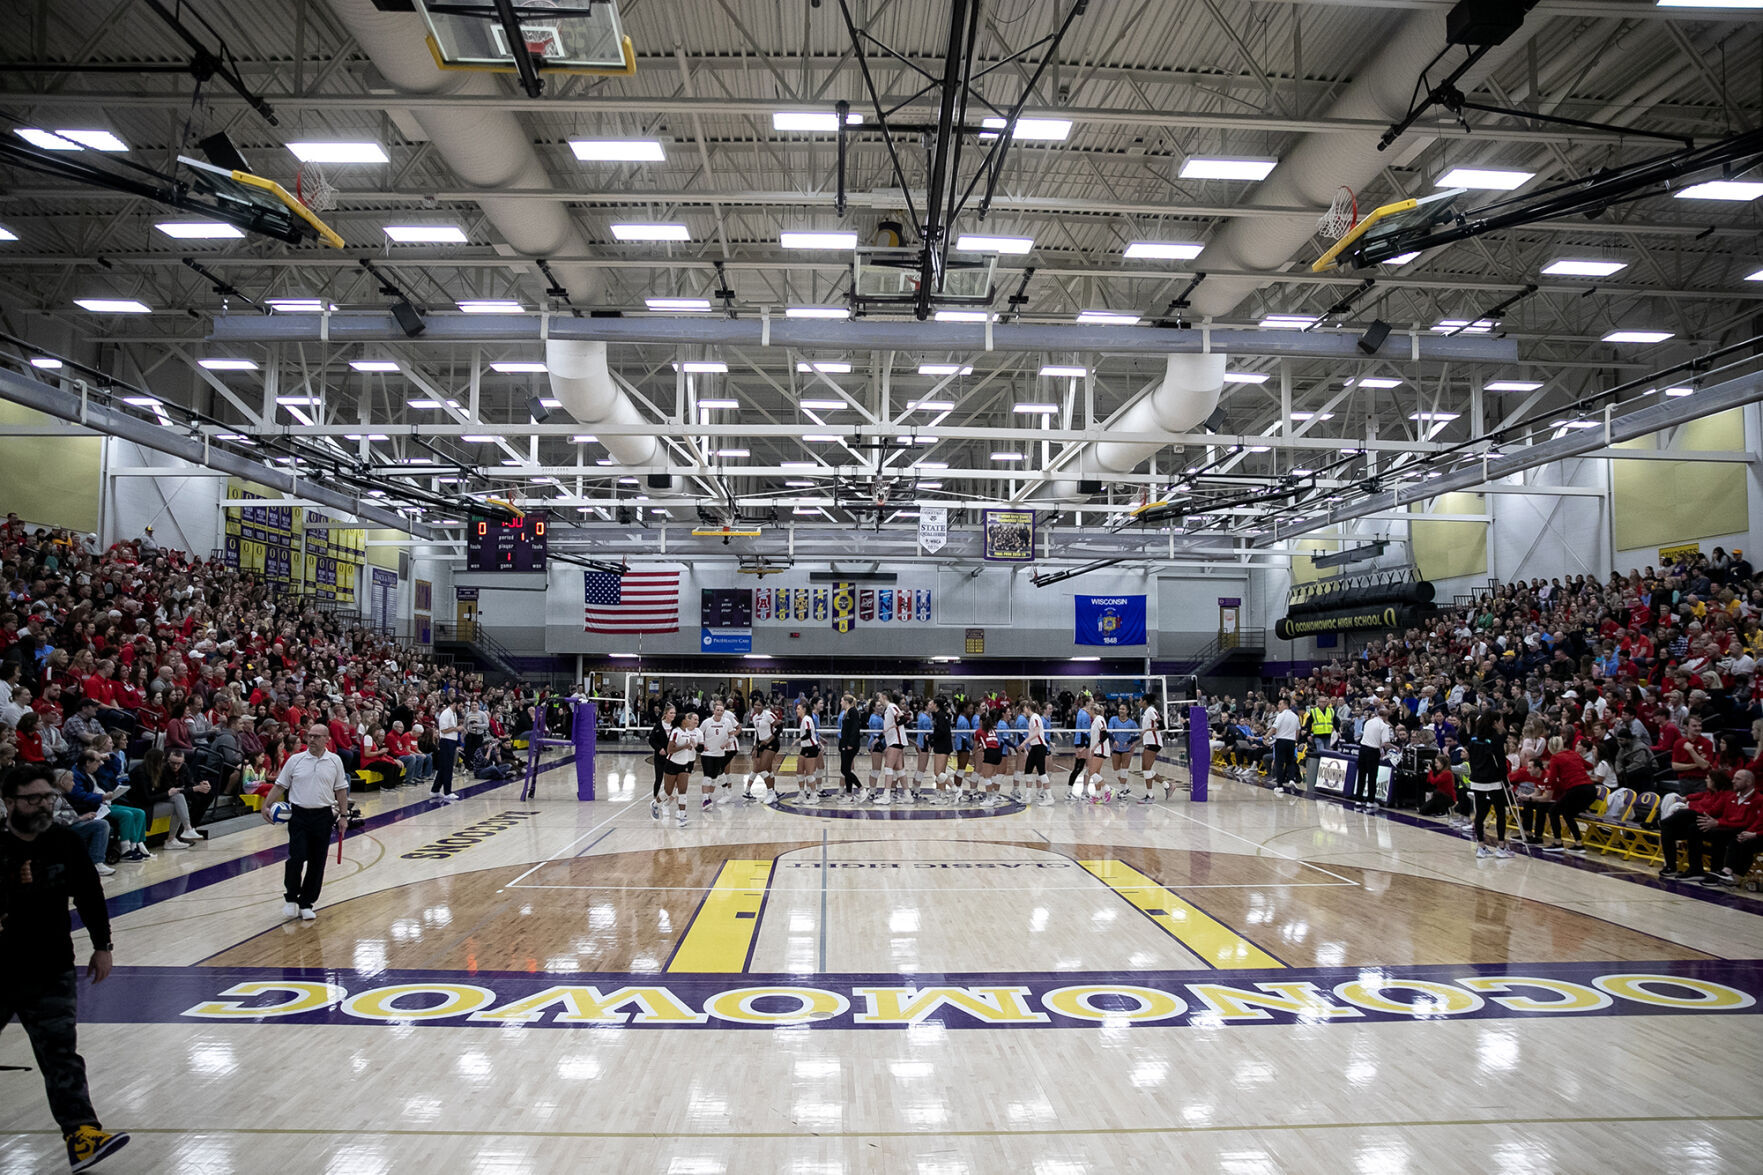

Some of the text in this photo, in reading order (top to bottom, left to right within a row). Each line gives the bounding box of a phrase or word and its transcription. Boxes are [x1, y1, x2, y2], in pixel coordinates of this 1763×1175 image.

[479, 522, 544, 536] 0 0
[1295, 621, 1336, 632] OCONOMOWOC
[1338, 616, 1353, 628] HIGH
[1354, 614, 1382, 626] SCHOOL
[400, 810, 542, 860] RACCOONS
[180, 974, 1757, 1027] OCONOMOWOC
